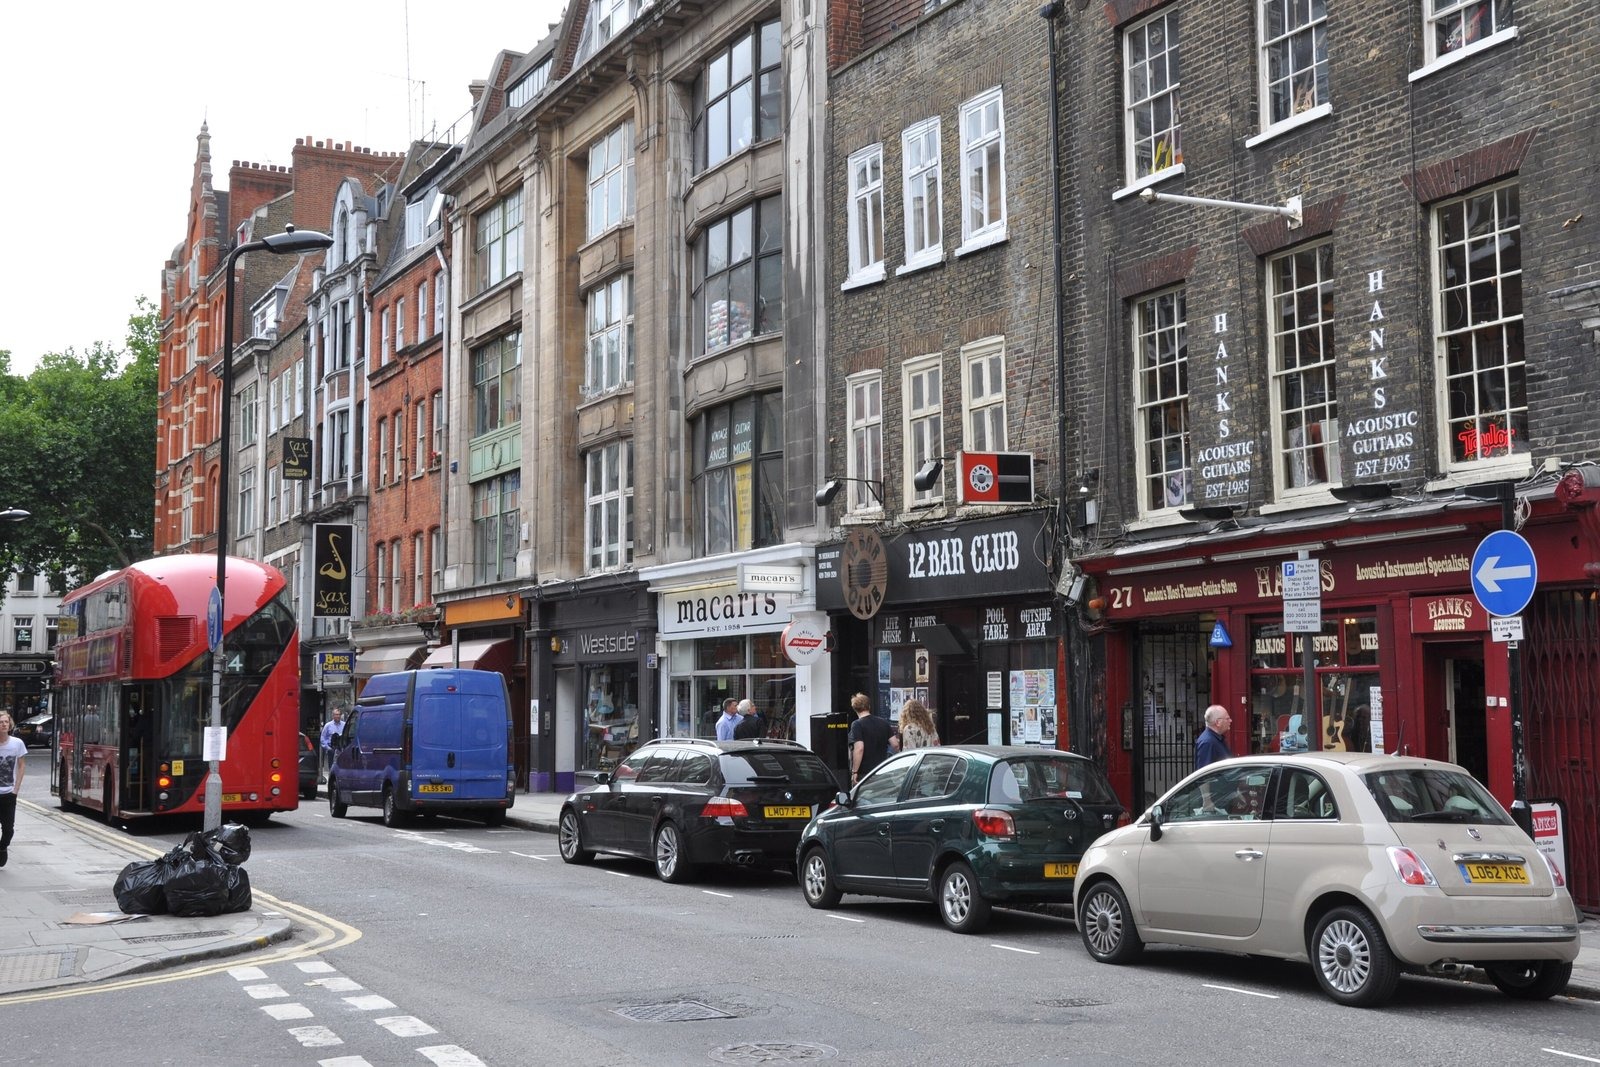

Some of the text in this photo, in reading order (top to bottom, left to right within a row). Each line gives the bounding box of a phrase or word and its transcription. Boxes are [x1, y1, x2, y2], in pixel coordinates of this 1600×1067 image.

[1368, 270, 1387, 409] HANKS
[1214, 313, 1230, 438] HANKS
[734, 421, 752, 435] GUITAR
[1346, 411, 1418, 437] ACOUSTIC
[732, 440, 752, 455] MUSIC
[1197, 440, 1254, 463] ACOUSTIC
[1352, 432, 1413, 455] GUITARS
[1202, 459, 1251, 479] GUITARS
[1355, 454, 1411, 478] EST 1985
[1205, 479, 1250, 498] EST 1985
[908, 530, 1020, 579] 12 BAR CLUB
[1356, 553, 1470, 580] Acoustic Instrument Specialists
[751, 575, 795, 583] macari's
[1110, 586, 1133, 609] 27
[1142, 579, 1238, 602] London's Most Famous Guitar Store
[986, 607, 1007, 624] POOL
[1020, 607, 1052, 622] OUTSIDE
[1427, 597, 1473, 620] HANKS
[885, 616, 899, 630] LIVE
[914, 615, 937, 628] NIGHTS
[1025, 621, 1046, 638] AREA
[1433, 618, 1466, 631] ACOUSTICS
[882, 630, 901, 644] MUSIC
[983, 624, 1009, 640] TABLE
[561, 640, 568, 654] 24
[580, 631, 636, 654] Westside
[1255, 638, 1286, 654] BANJOS
[791, 807, 807, 816] FJF
[1532, 816, 1557, 831] ANKS
[1502, 866, 1526, 880] XGC
